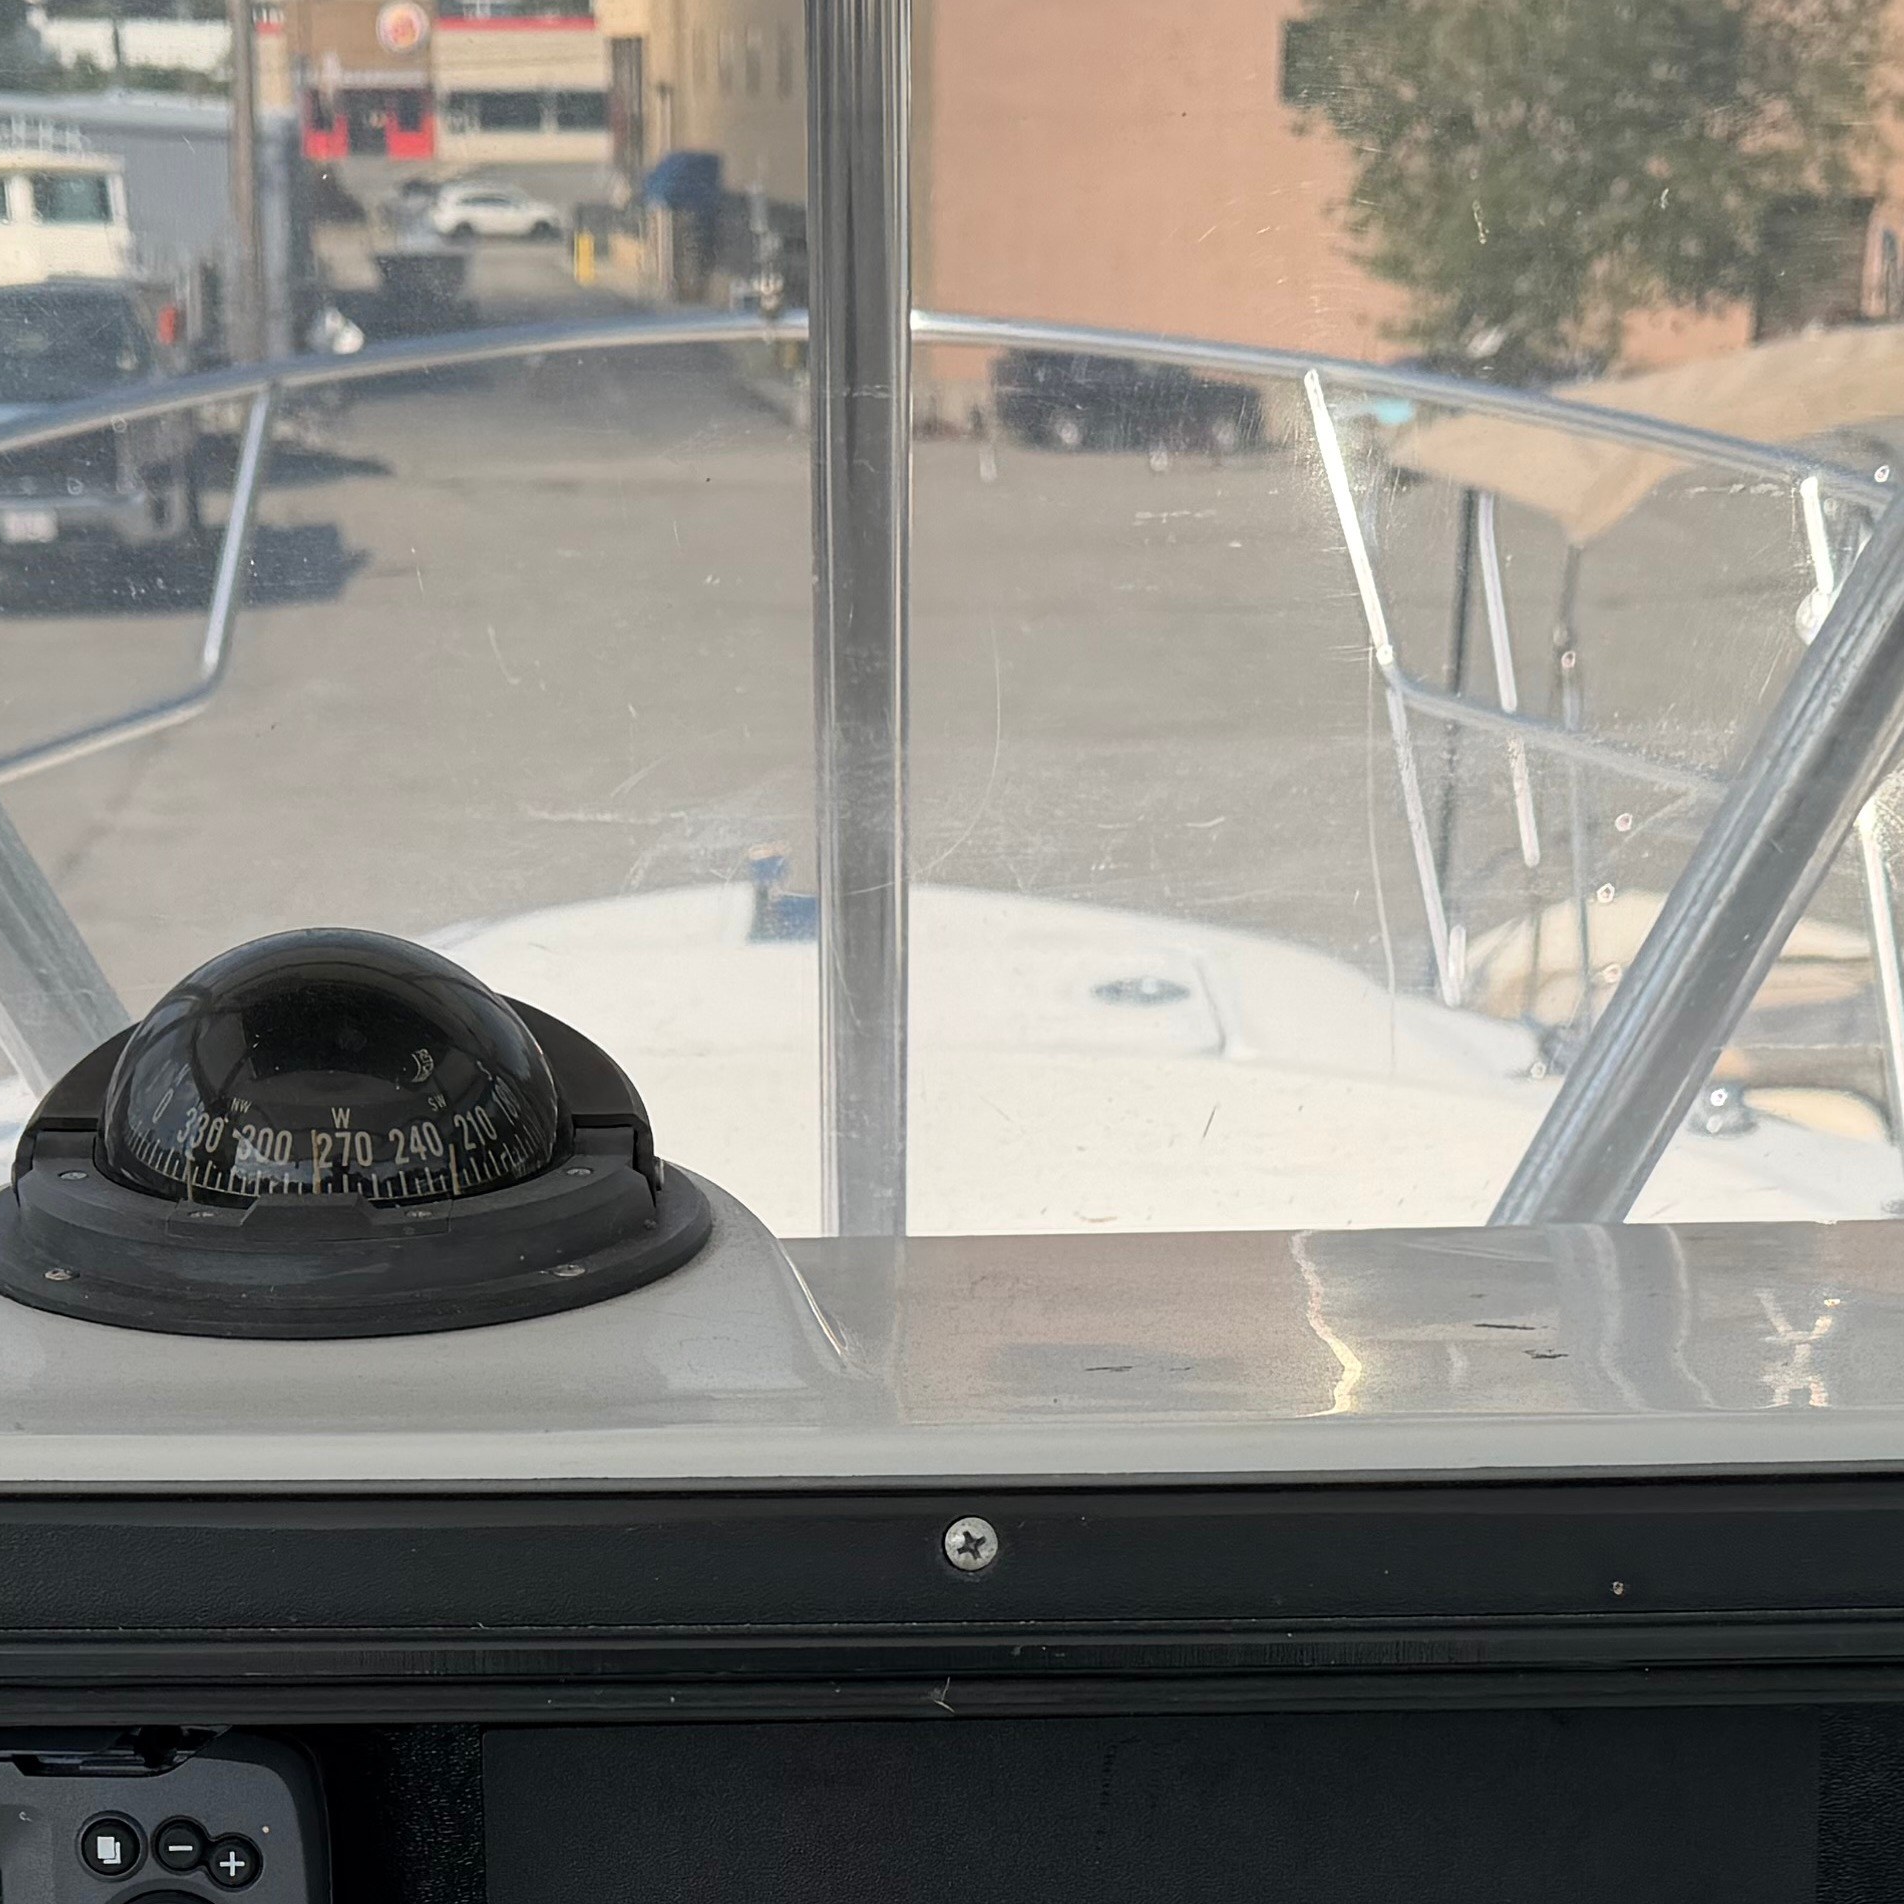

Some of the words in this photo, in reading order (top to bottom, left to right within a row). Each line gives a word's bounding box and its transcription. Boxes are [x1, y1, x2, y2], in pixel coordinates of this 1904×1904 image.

[230, 1097, 253, 1114] NW
[330, 1106, 352, 1128] W
[427, 1093, 448, 1112] SW
[176, 1105, 225, 1154] 330
[237, 1124, 293, 1166] 300
[318, 1131, 373, 1167] 270
[388, 1121, 445, 1164] 240
[453, 1105, 498, 1151] 210
